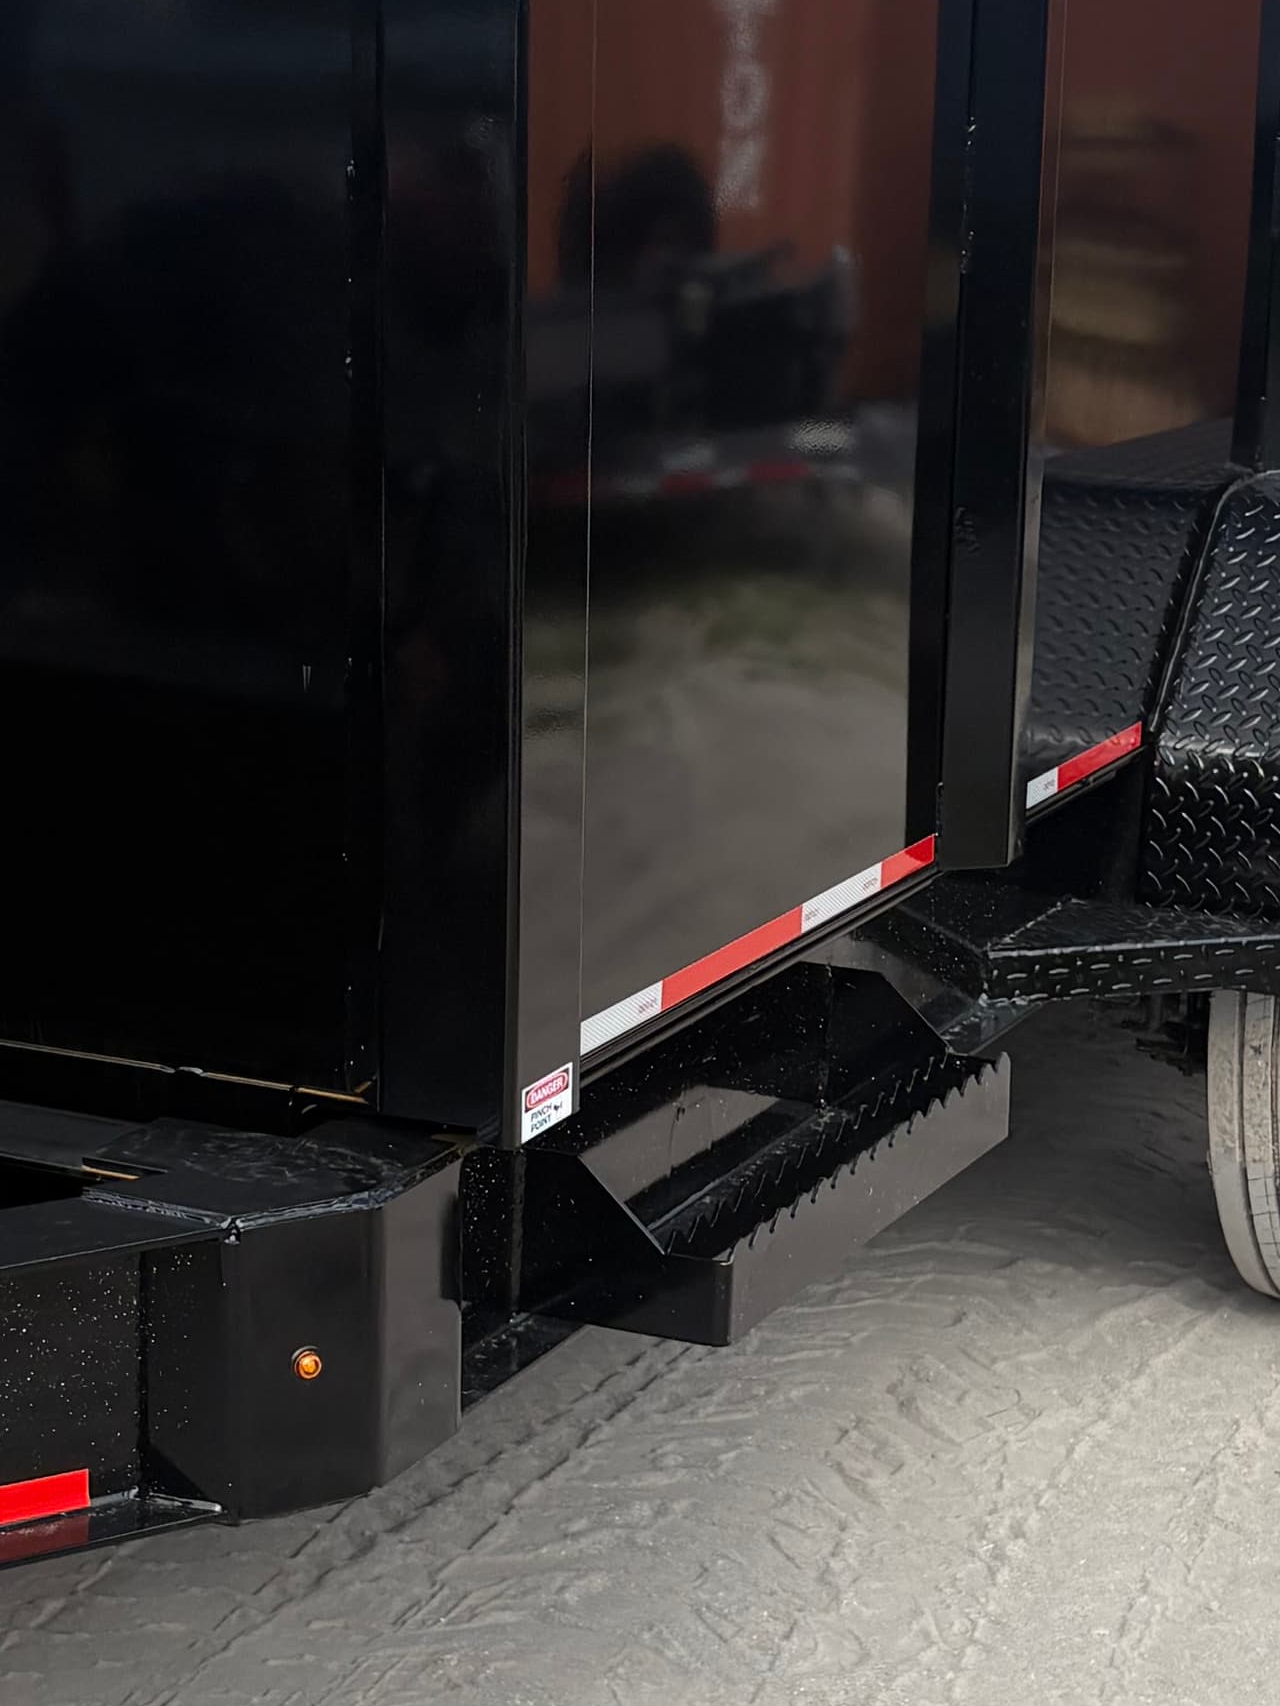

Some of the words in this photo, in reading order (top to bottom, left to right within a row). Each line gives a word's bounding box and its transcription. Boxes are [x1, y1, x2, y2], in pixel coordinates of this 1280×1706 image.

[530, 1077, 563, 1104] DANGER
[530, 1103, 553, 1122] PINCH
[530, 1114, 551, 1133] POINT
